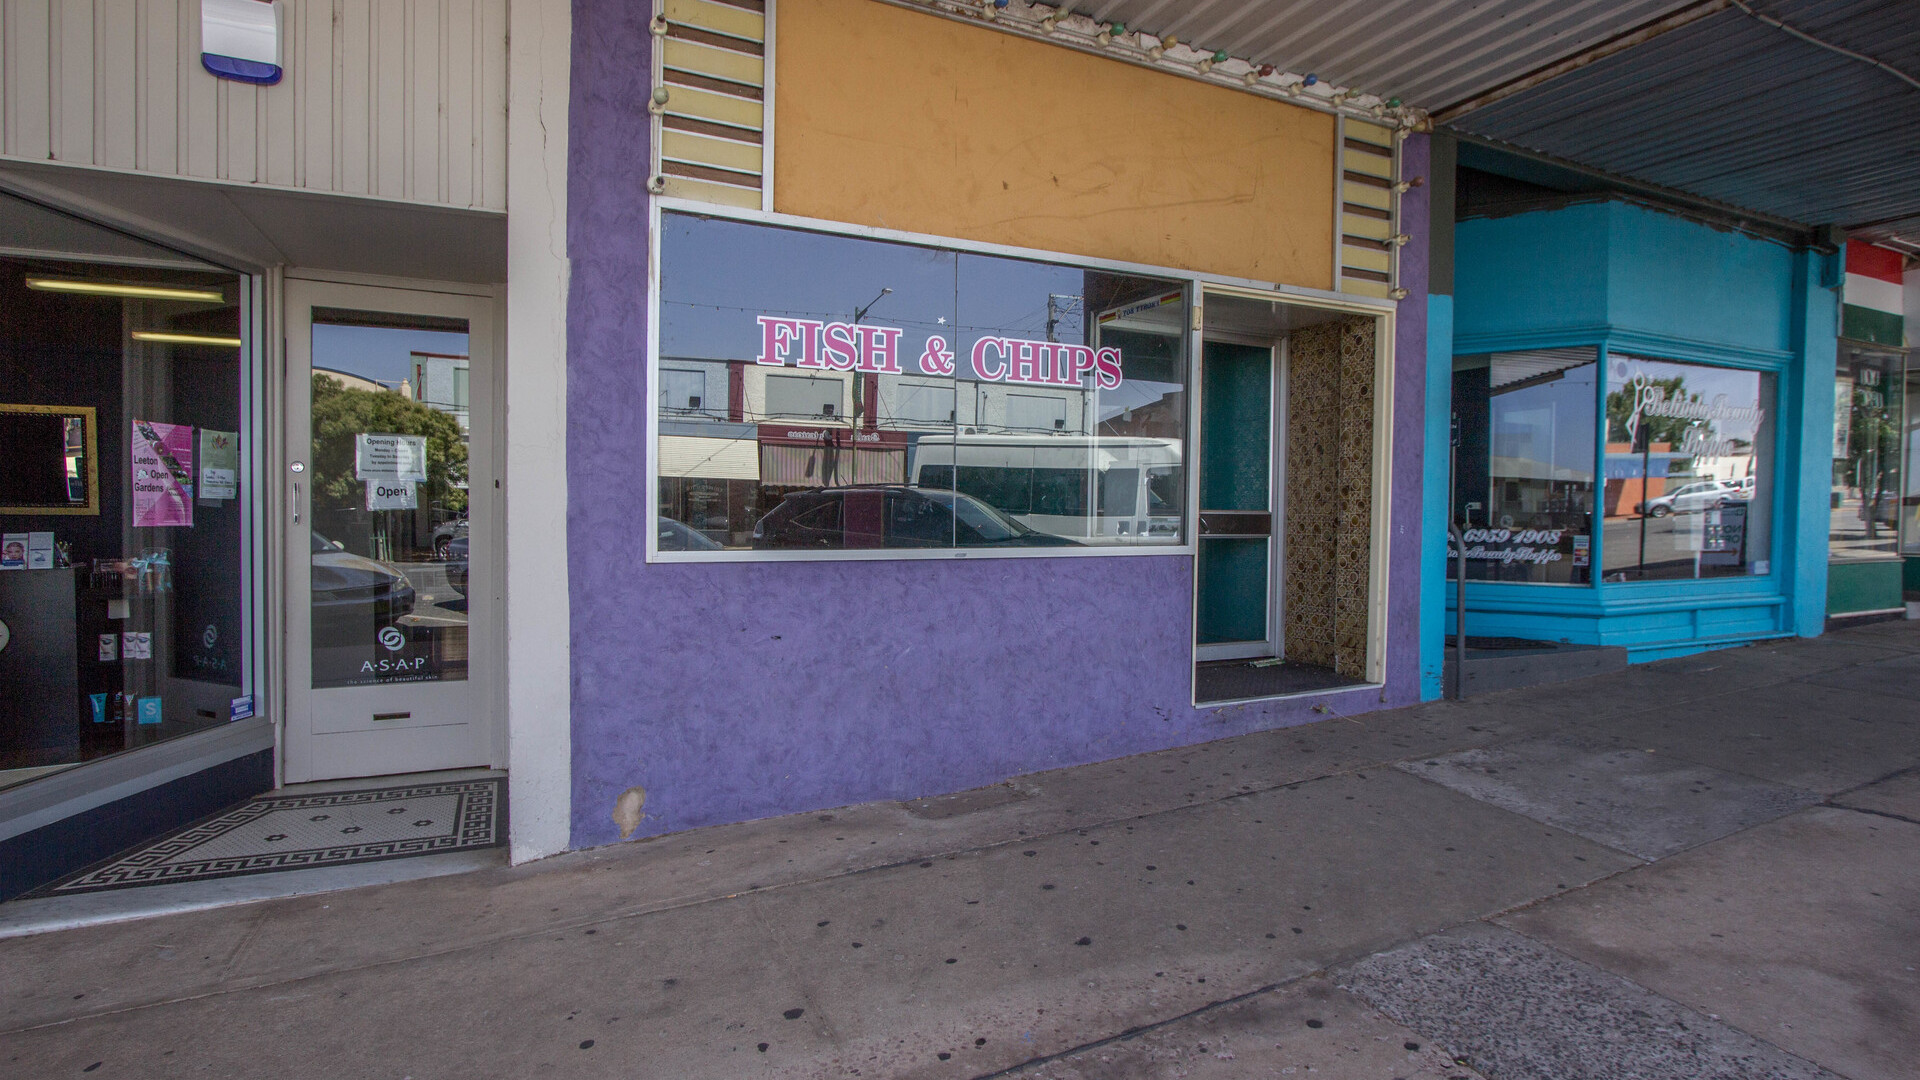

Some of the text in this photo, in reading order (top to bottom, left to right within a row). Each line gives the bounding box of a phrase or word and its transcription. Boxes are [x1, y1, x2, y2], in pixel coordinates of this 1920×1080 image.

[756, 315, 1123, 390] FISH & CHIPS
[366, 437, 395, 447] Opening
[133, 455, 158, 465] Leeton
[150, 469, 169, 480] Open
[134, 482, 164, 493] Gardens
[376, 486, 408, 499] Open
[1463, 528, 1511, 543] 6959
